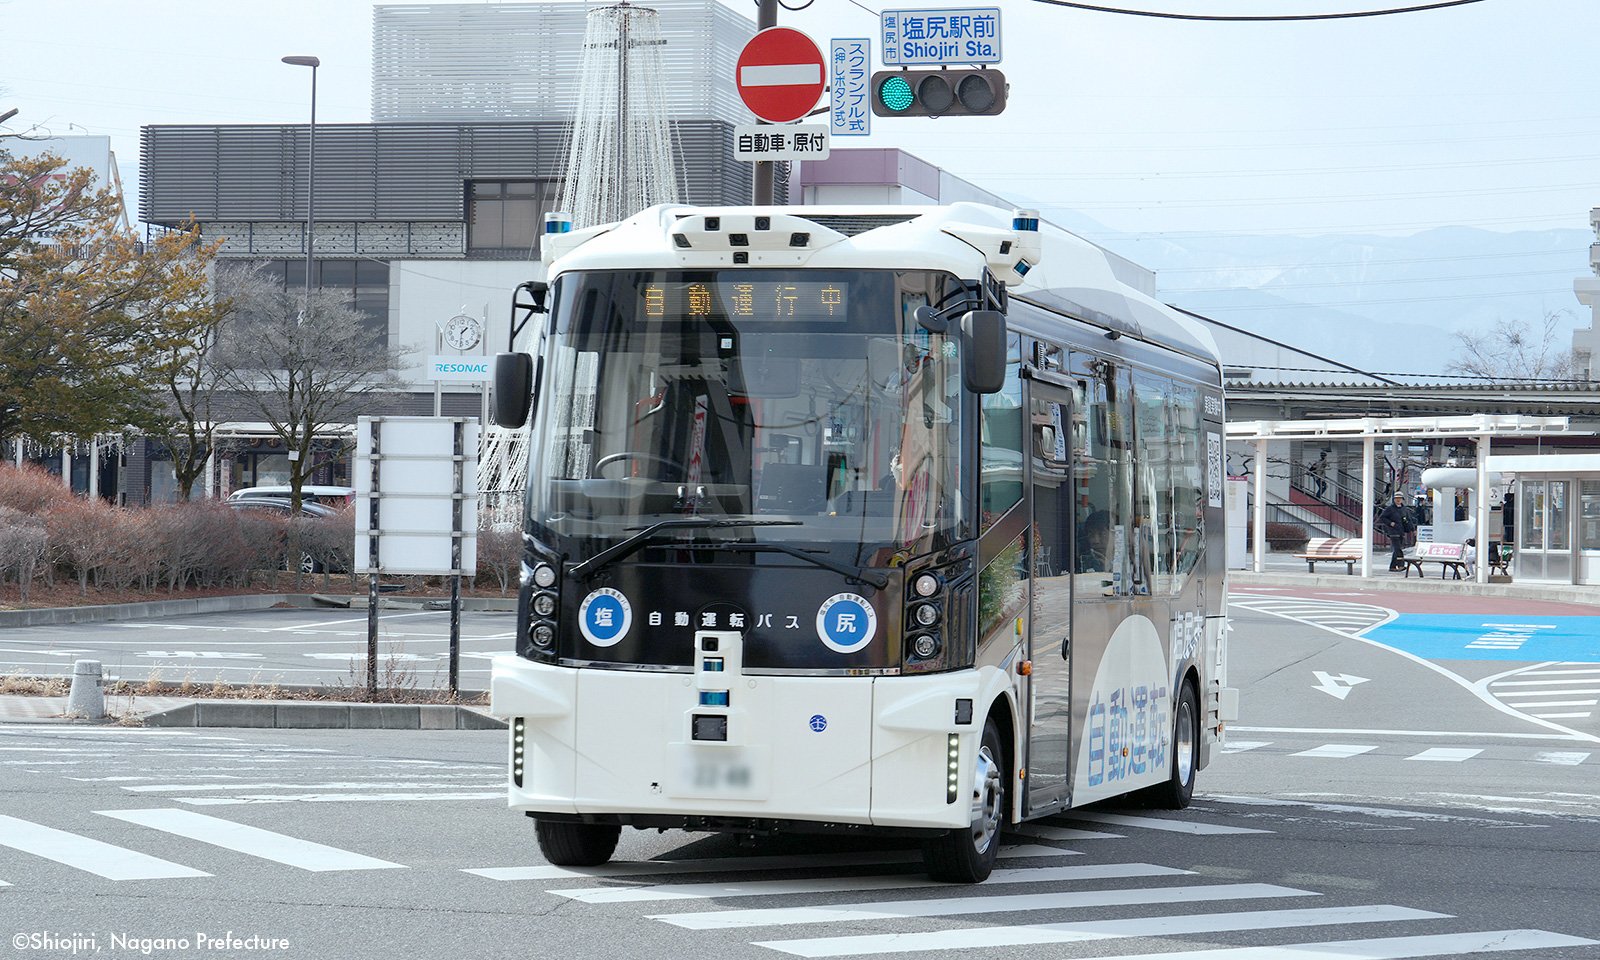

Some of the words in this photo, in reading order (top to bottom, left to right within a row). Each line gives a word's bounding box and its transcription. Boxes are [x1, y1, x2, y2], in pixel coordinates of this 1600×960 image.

[884, 16, 897, 59] 塩尻市
[902, 15, 995, 40] 塩尻駅前
[903, 41, 959, 60] Shiojiri
[966, 40, 996, 57] Sta.
[848, 43, 865, 131] スクランブル式
[739, 133, 825, 152] 自動車・原付
[645, 284, 841, 315] 自動運行中
[435, 363, 488, 373] RESONAC
[594, 607, 613, 627] 塩
[648, 611, 800, 629] 自動運転バス
[835, 613, 856, 633] 尻
[1088, 682, 1166, 787] 自動運転
